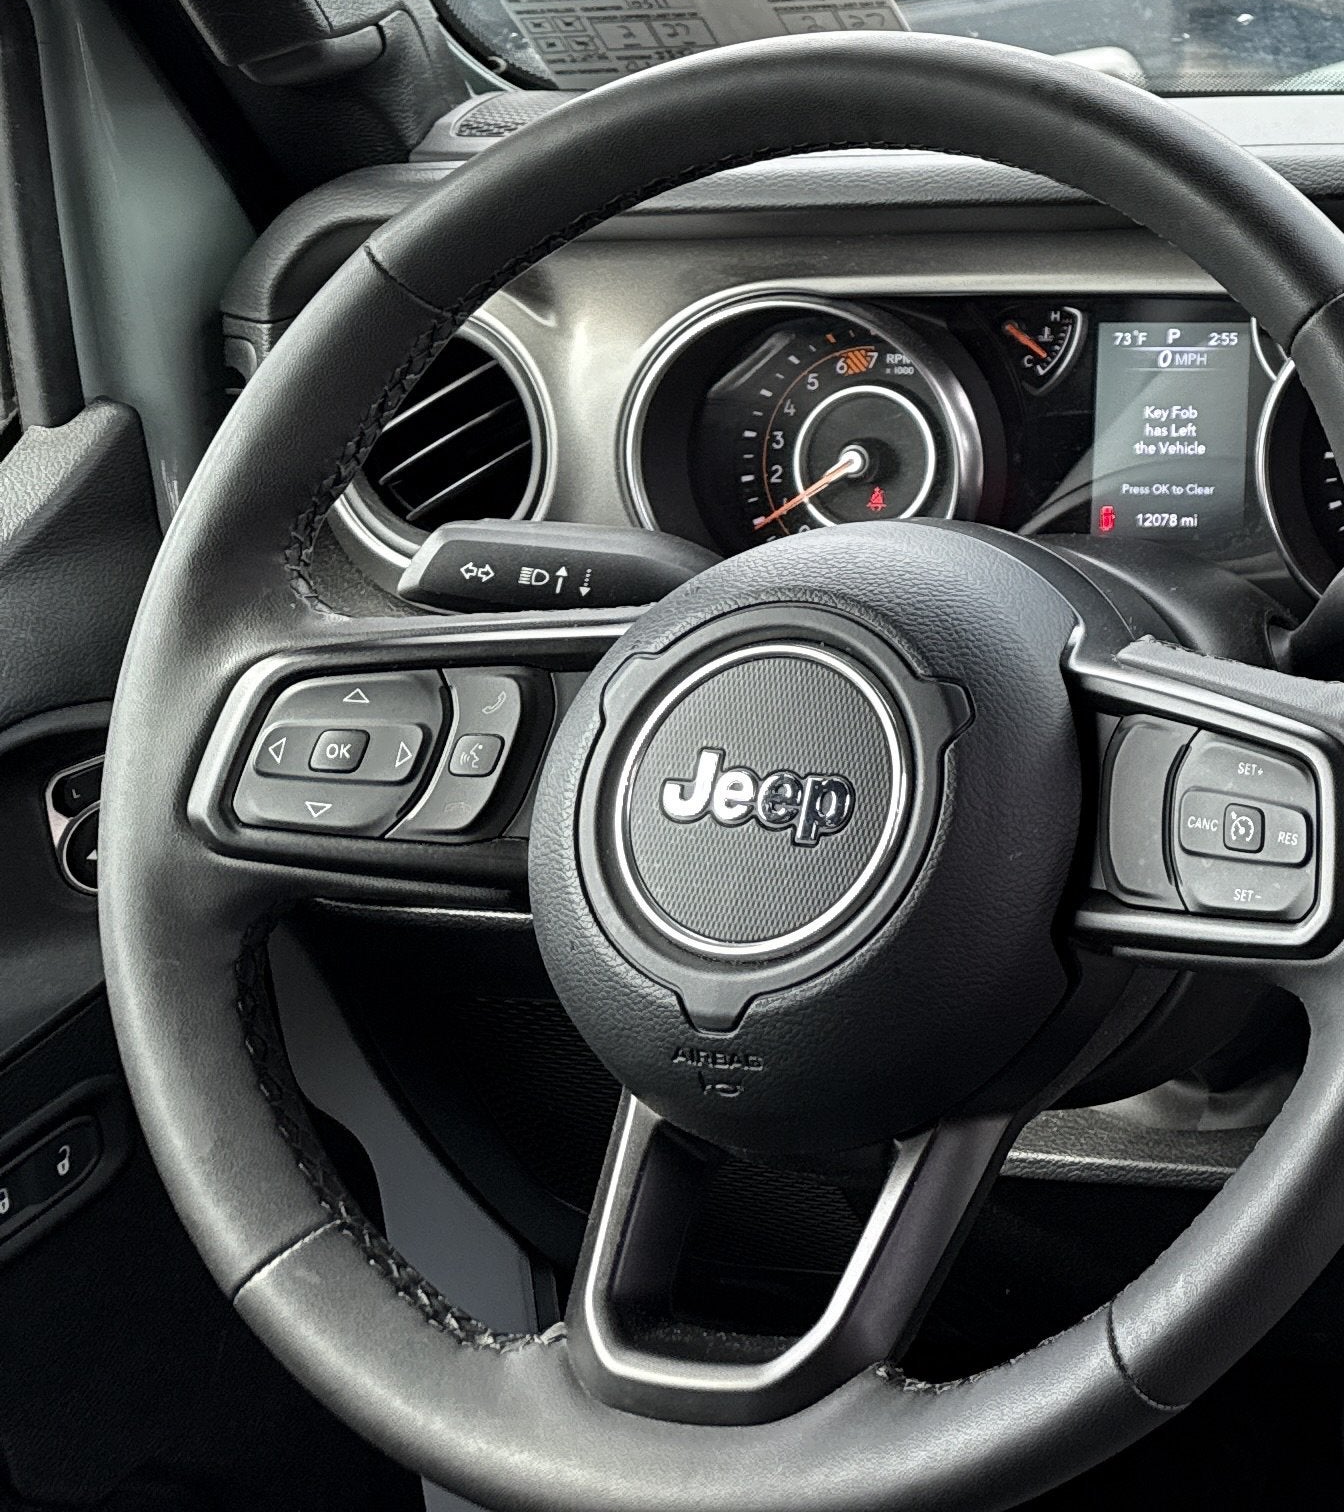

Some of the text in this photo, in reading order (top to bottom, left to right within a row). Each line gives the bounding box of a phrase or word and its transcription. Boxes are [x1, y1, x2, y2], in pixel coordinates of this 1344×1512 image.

[1051, 310, 1061, 322] H
[1112, 329, 1148, 346] 73°F
[1165, 328, 1182, 344] P
[1207, 332, 1239, 347] 2:55
[835, 356, 849, 375] 6
[866, 351, 879, 369] 7
[1023, 355, 1035, 368] C
[1157, 349, 1208, 368] 0 MPH
[806, 372, 819, 391] 5
[783, 400, 797, 417] 4
[1143, 405, 1199, 421] Key Fob
[1145, 423, 1197, 438] has Left
[771, 431, 785, 450] 3
[1133, 441, 1207, 456] the Vehicle
[770, 464, 784, 484] 2
[1121, 483, 1216, 496] Press OK to Clear
[1135, 513, 1199, 528] 12078 mi
[325, 742, 352, 760] OK
[660, 748, 855, 845] Jeep
[1186, 815, 1220, 833] CANC
[1276, 830, 1299, 847] RES
[670, 1047, 764, 1072] AIRBAG
